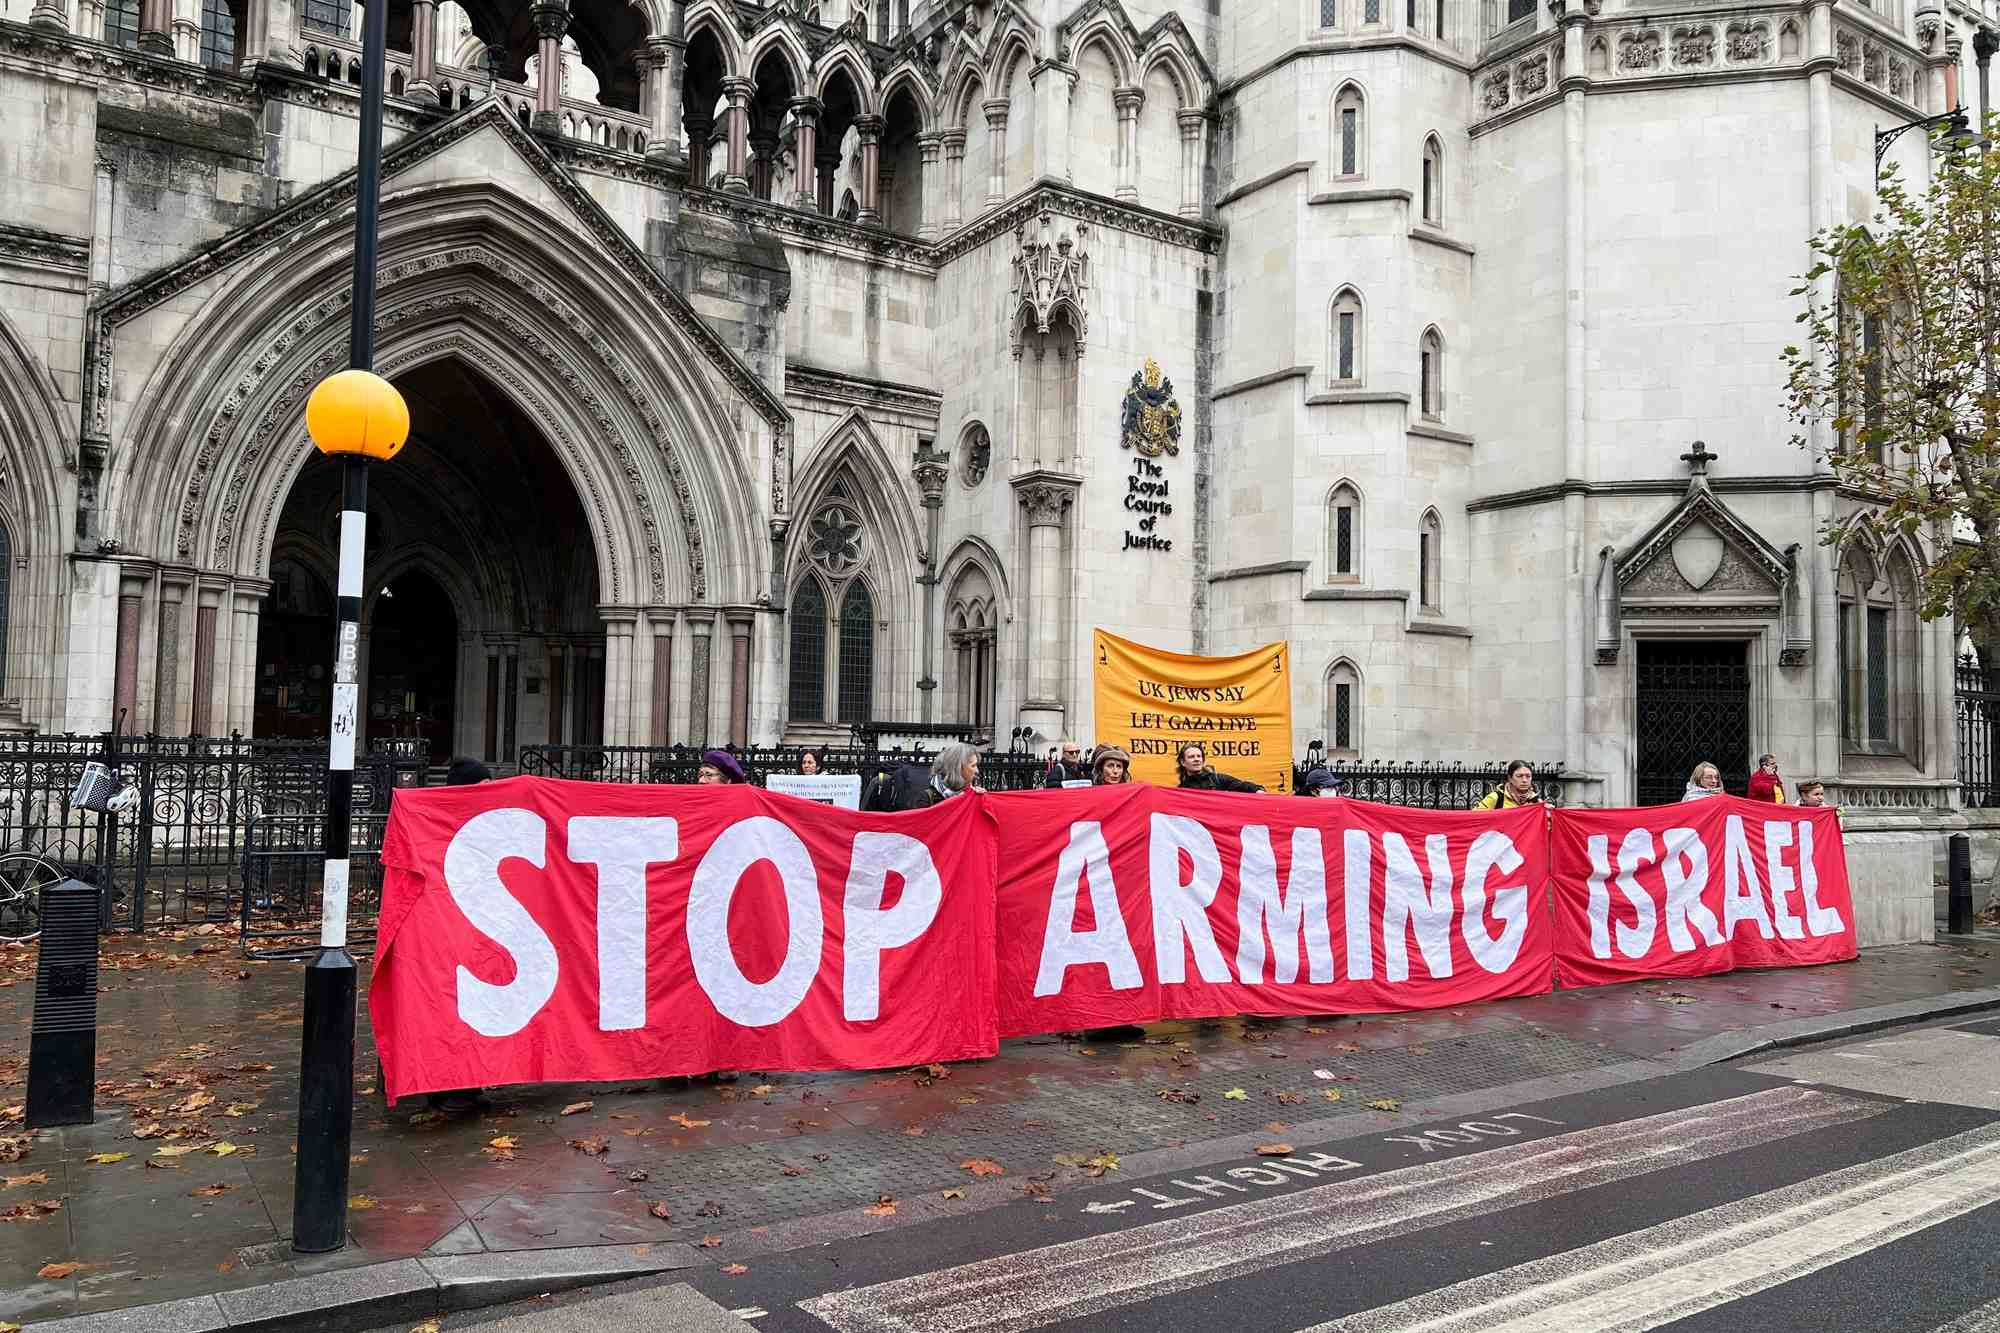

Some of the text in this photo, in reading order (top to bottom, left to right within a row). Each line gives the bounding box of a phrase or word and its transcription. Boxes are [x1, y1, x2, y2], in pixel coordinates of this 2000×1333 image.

[1134, 458, 1163, 478] The
[1128, 475, 1169, 497] Royal
[1124, 494, 1172, 516] Courts
[1139, 515, 1157, 532] of
[1122, 530, 1173, 552] Justice
[1138, 680, 1246, 703] UK JEWS SAY
[1130, 712, 1257, 731] LET GAZA LIVE
[1130, 738, 1260, 756] END TE SIEGE
[444, 807, 1845, 1037] STOP ARMING ISRAEL
[1131, 1112, 1567, 1210] LOOK RIGHT
